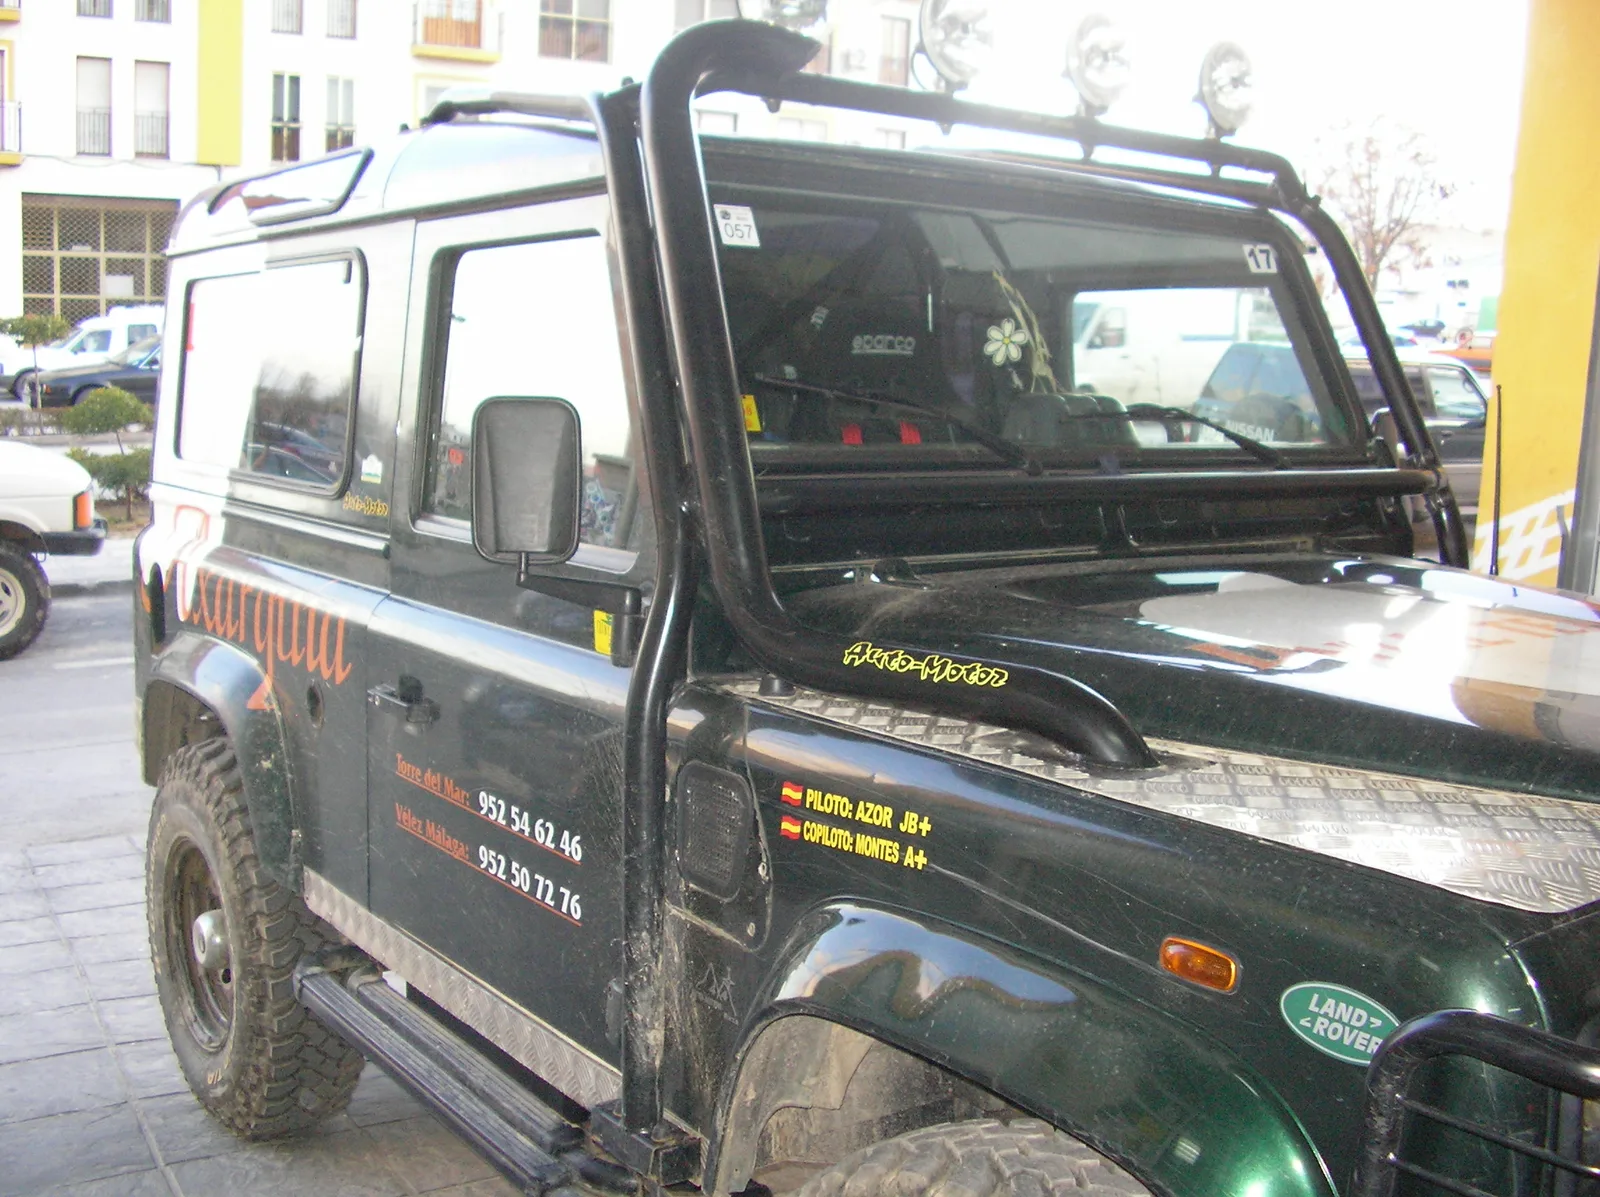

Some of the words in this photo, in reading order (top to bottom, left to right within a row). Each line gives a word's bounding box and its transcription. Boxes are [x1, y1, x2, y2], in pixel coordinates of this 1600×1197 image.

[724, 223, 753, 239] 057
[1248, 248, 1271, 269] 17
[396, 753, 421, 783] Torre
[424, 768, 441, 793] del
[444, 777, 470, 806] Mar:
[478, 791, 506, 826] 952
[511, 806, 530, 837] 54
[534, 819, 555, 849] 62
[559, 830, 582, 862] 46
[805, 789, 852, 818] PILOTO:
[855, 801, 893, 828] AZOR
[899, 811, 931, 837] JB+
[395, 802, 422, 834] Vélez
[426, 819, 469, 860] Málaga:
[478, 845, 506, 880] 952
[511, 861, 530, 893] 50
[534, 874, 554, 907] 72
[559, 887, 581, 920] 76
[803, 821, 853, 852] COPILOTO:
[855, 833, 899, 864] MONTES
[903, 846, 927, 870] A+
[1308, 993, 1368, 1028] LAND
